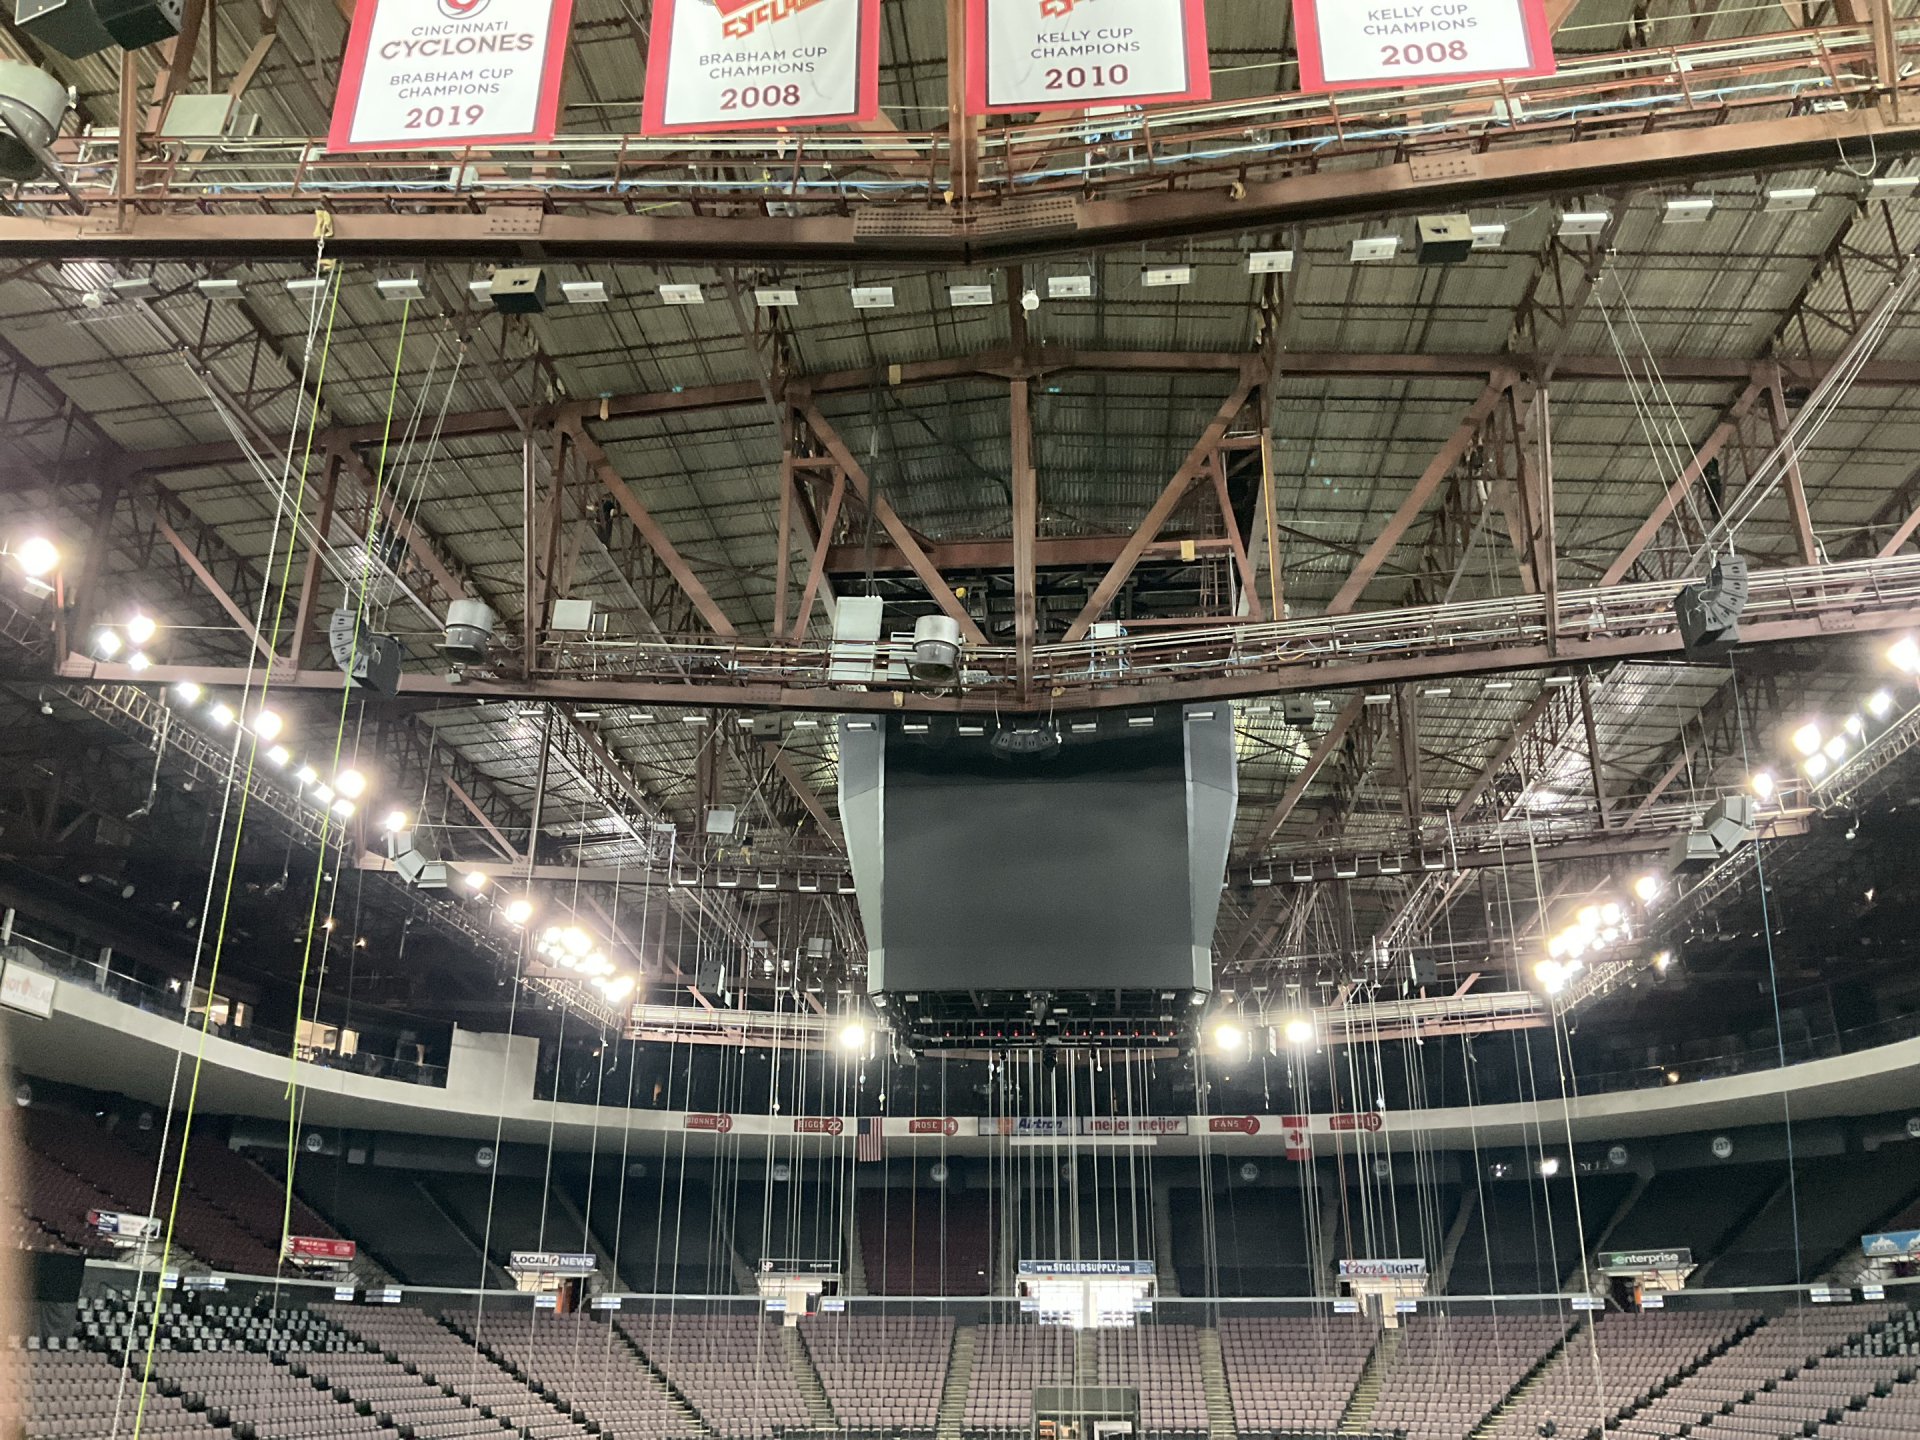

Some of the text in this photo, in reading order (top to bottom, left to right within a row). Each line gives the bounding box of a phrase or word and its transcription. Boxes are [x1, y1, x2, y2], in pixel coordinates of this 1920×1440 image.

[1367, 4, 1468, 21] KELLY CUP
[411, 21, 508, 36] CINCINNATI
[1363, 17, 1478, 35] CHAMPIONS
[1037, 28, 1133, 44] KELLY CUP
[379, 33, 535, 60] CYCLONES
[1030, 41, 1140, 59] CHAMPIONS
[1380, 39, 1468, 66] 2008
[699, 47, 828, 66] BRABHAM CUP
[390, 68, 513, 86] BRABHAM CUP
[709, 62, 815, 79] CHAMPIONS
[1045, 64, 1129, 90] 2010
[398, 83, 500, 99] CHAMPIONS
[719, 84, 801, 110] 2008
[404, 104, 484, 128] 2019
[687, 1117, 729, 1128] DIONNE 21
[828, 1121, 841, 1131] 22
[915, 1121, 955, 1131] ROSE 14
[1214, 1119, 1254, 1130] FANS 7
[513, 1256, 548, 1264] LOCAL
[560, 1257, 594, 1266] NEWS
[1344, 1260, 1419, 1274] Coors LIGHT
[1612, 1252, 1678, 1265] enterprise
